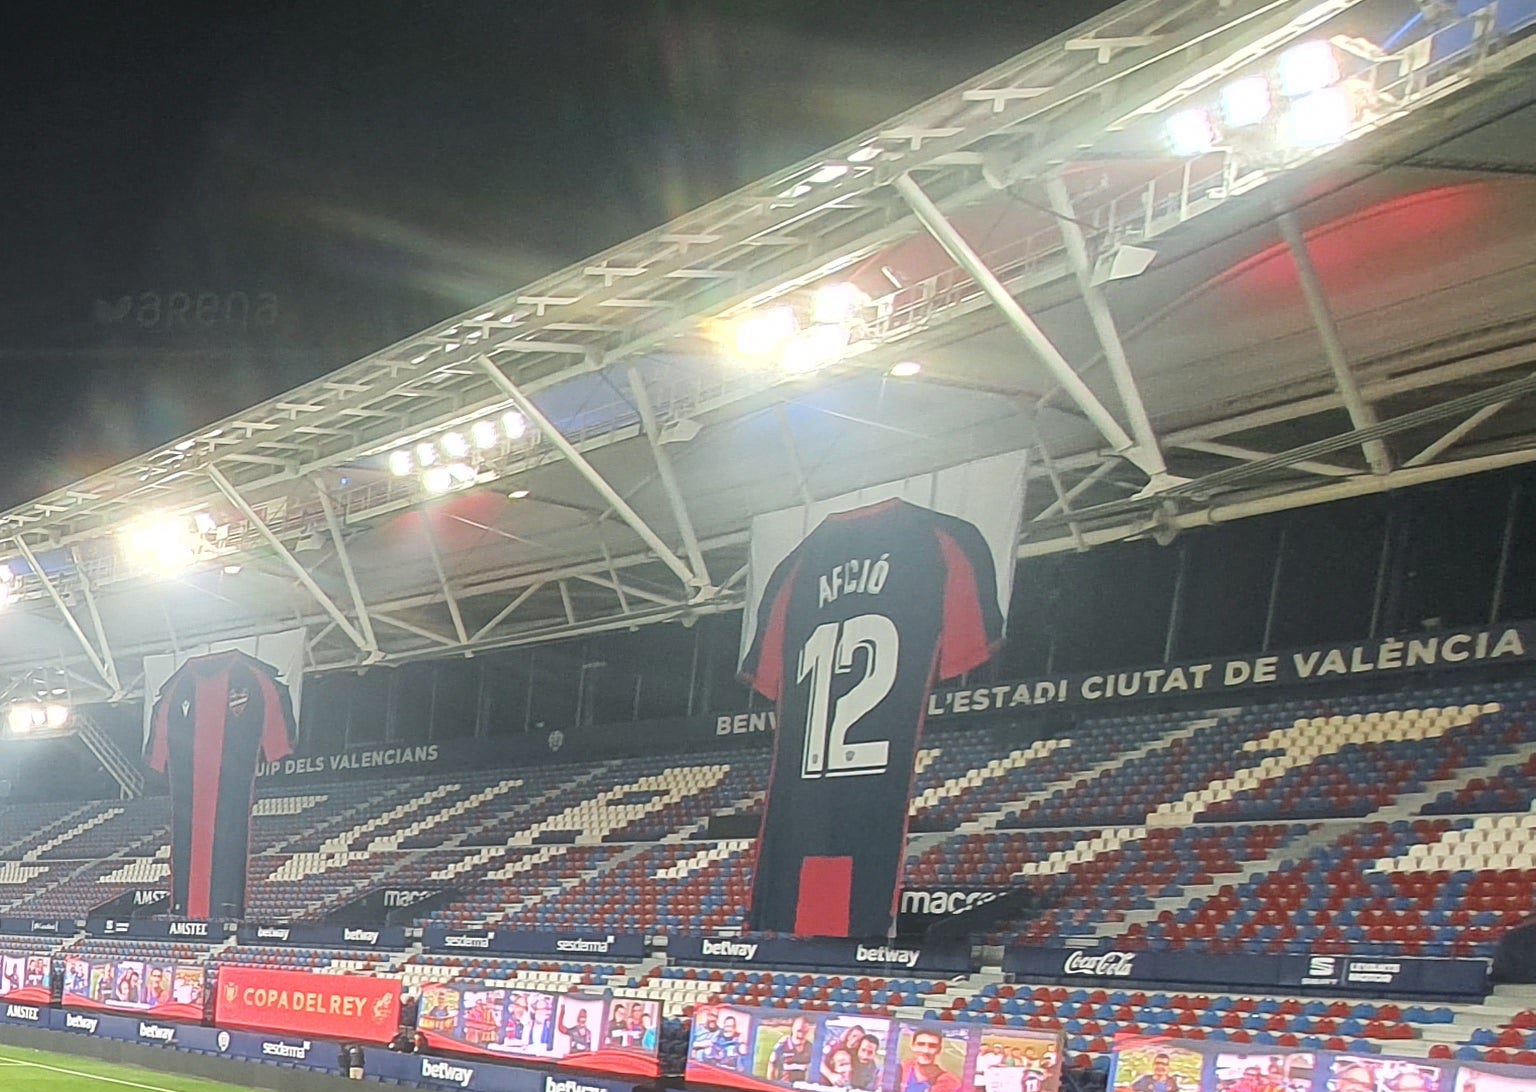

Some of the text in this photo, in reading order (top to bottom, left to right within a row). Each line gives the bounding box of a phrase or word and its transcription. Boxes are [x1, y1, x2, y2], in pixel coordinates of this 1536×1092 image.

[818, 553, 892, 608] AFCIÓ
[929, 677, 1067, 717] L'ESTADI
[1080, 663, 1212, 701] CIUTAT
[1224, 656, 1279, 686] DE
[1293, 627, 1526, 679] VALÈNCIA
[795, 613, 901, 779] 12
[284, 756, 325, 774] DELS
[329, 745, 439, 772] VALENCIANS
[169, 922, 208, 935] AMSTEL
[344, 928, 379, 944] betway
[702, 939, 757, 960] betway
[856, 944, 920, 966] betway
[6, 1005, 39, 1021] AMSTEL
[243, 987, 368, 1017] COPA DEL REY
[139, 1023, 175, 1041] betway
[422, 1060, 474, 1087] betway
